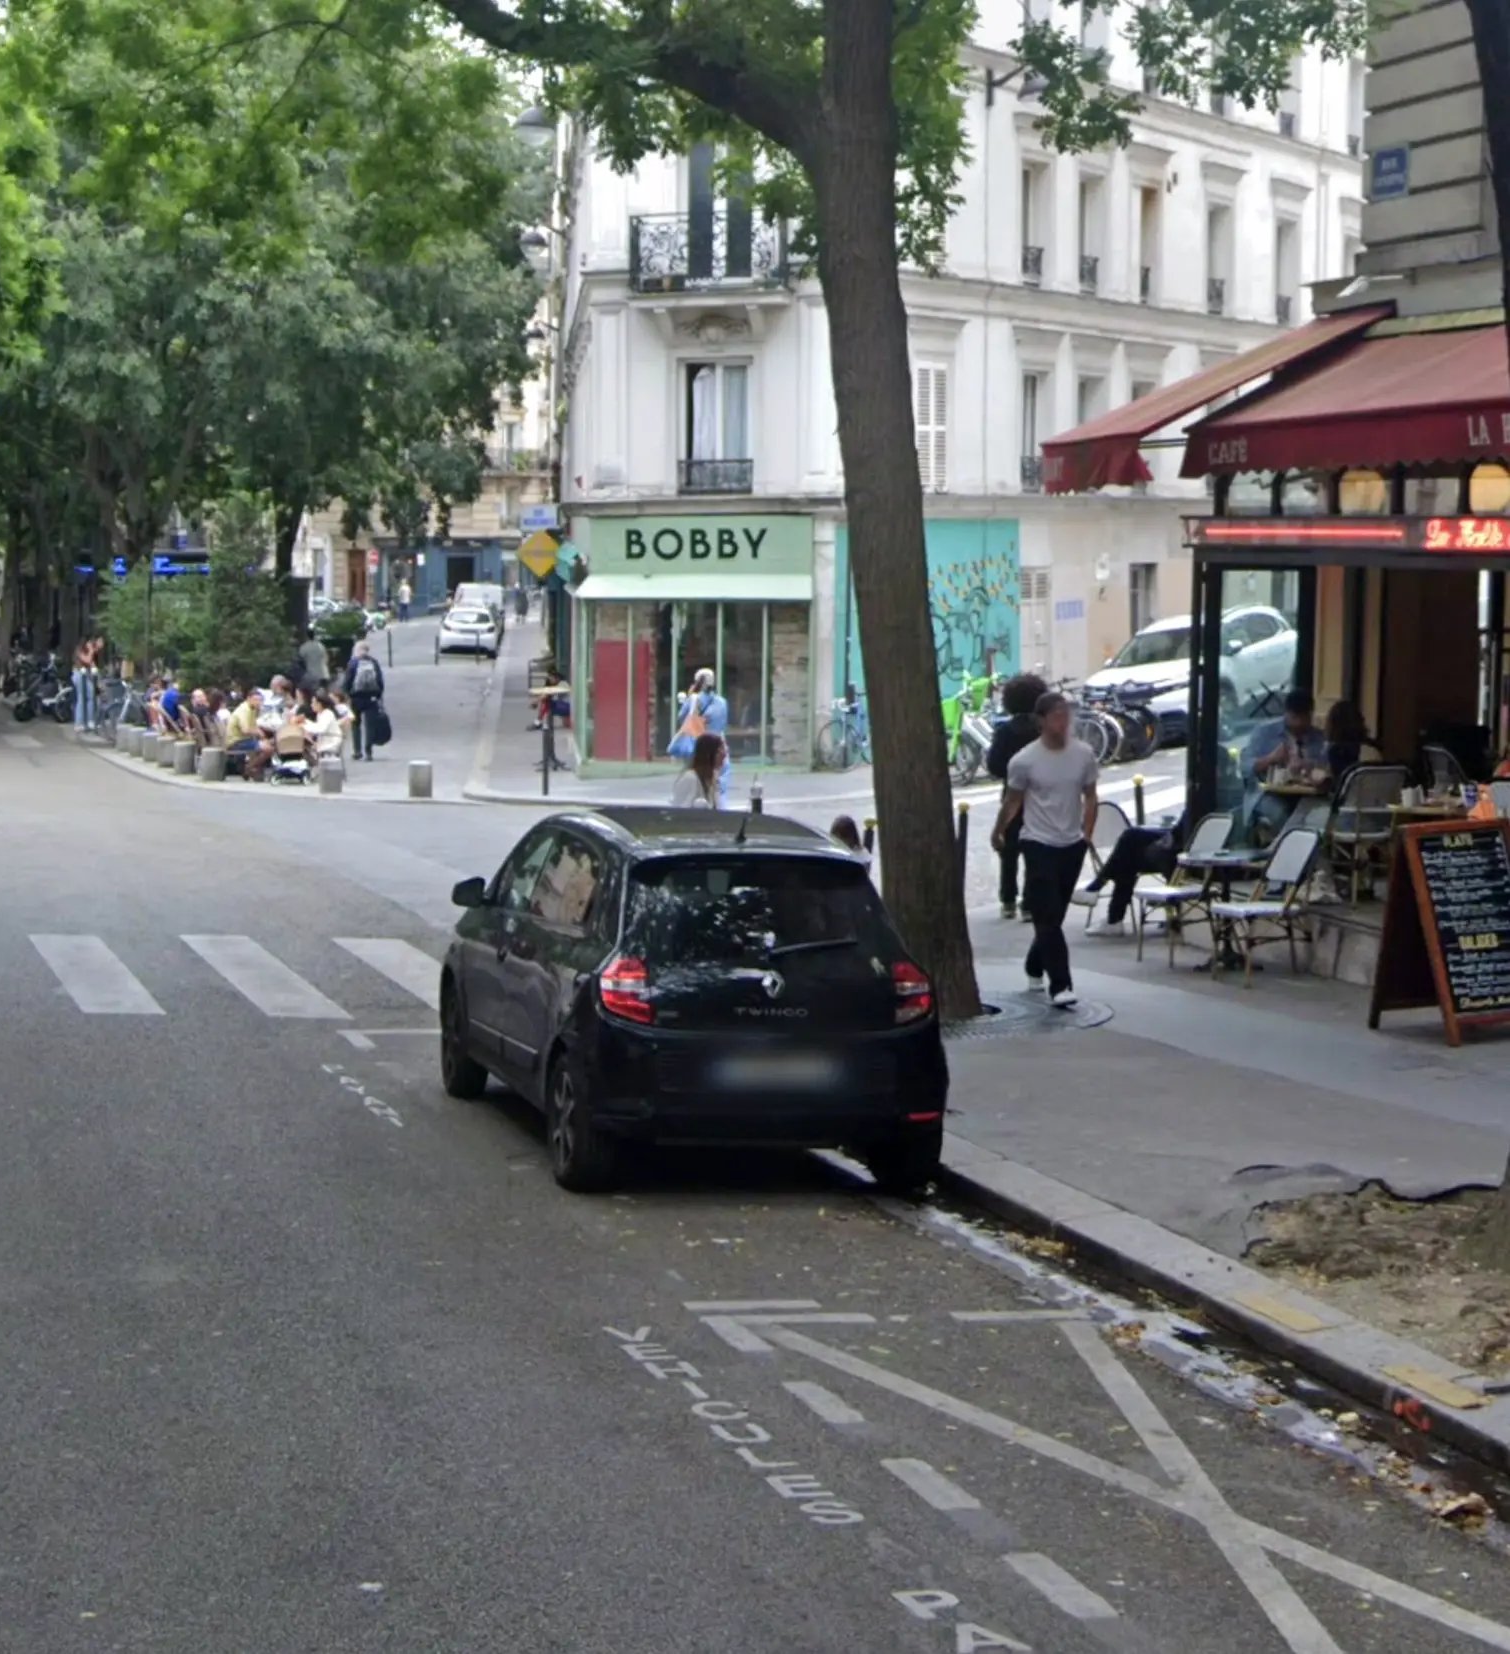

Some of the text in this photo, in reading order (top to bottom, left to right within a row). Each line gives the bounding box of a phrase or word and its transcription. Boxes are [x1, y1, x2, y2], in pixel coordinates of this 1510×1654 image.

[1467, 415, 1491, 446] LA
[625, 528, 768, 560] BOBBY
[733, 1006, 809, 1018] TWINGO
[602, 1325, 864, 1525] VEHICULES
